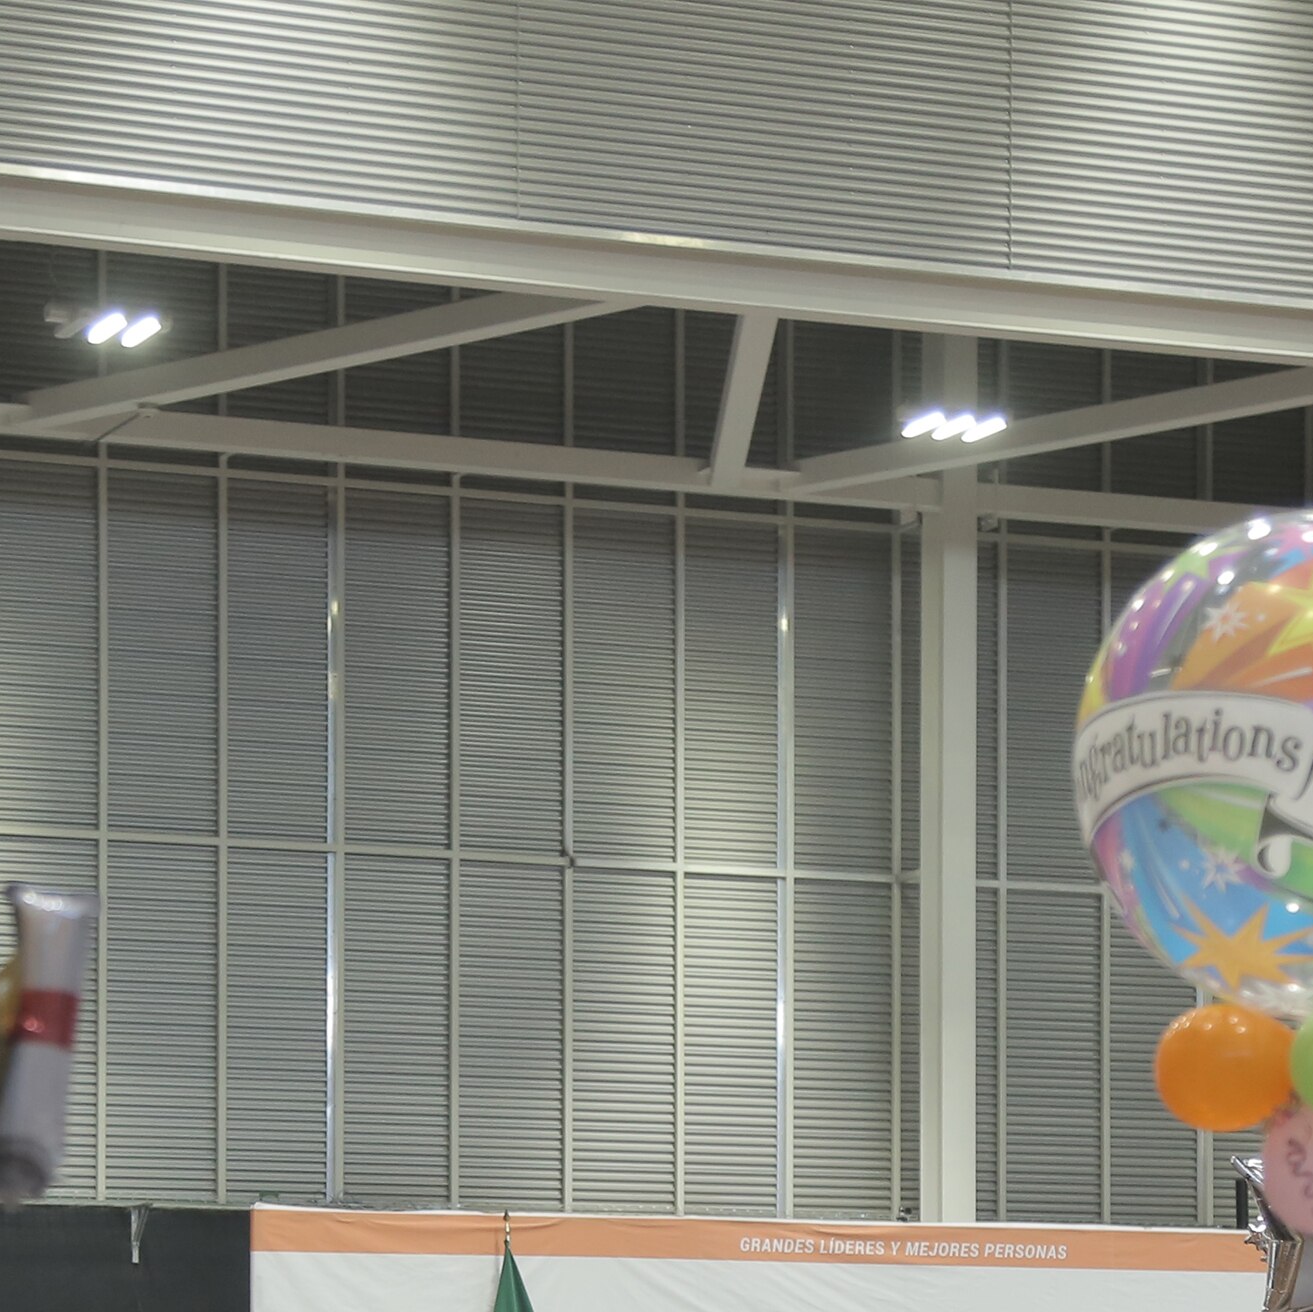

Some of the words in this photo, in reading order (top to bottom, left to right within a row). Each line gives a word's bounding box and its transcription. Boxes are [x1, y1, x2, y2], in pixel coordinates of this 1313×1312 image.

[740, 1237, 815, 1254] GRANDES
[819, 1237, 885, 1256] LÍDERES
[891, 1241, 901, 1255] Y
[905, 1241, 980, 1258] MEJORES
[984, 1243, 1068, 1260] PERSONAS
